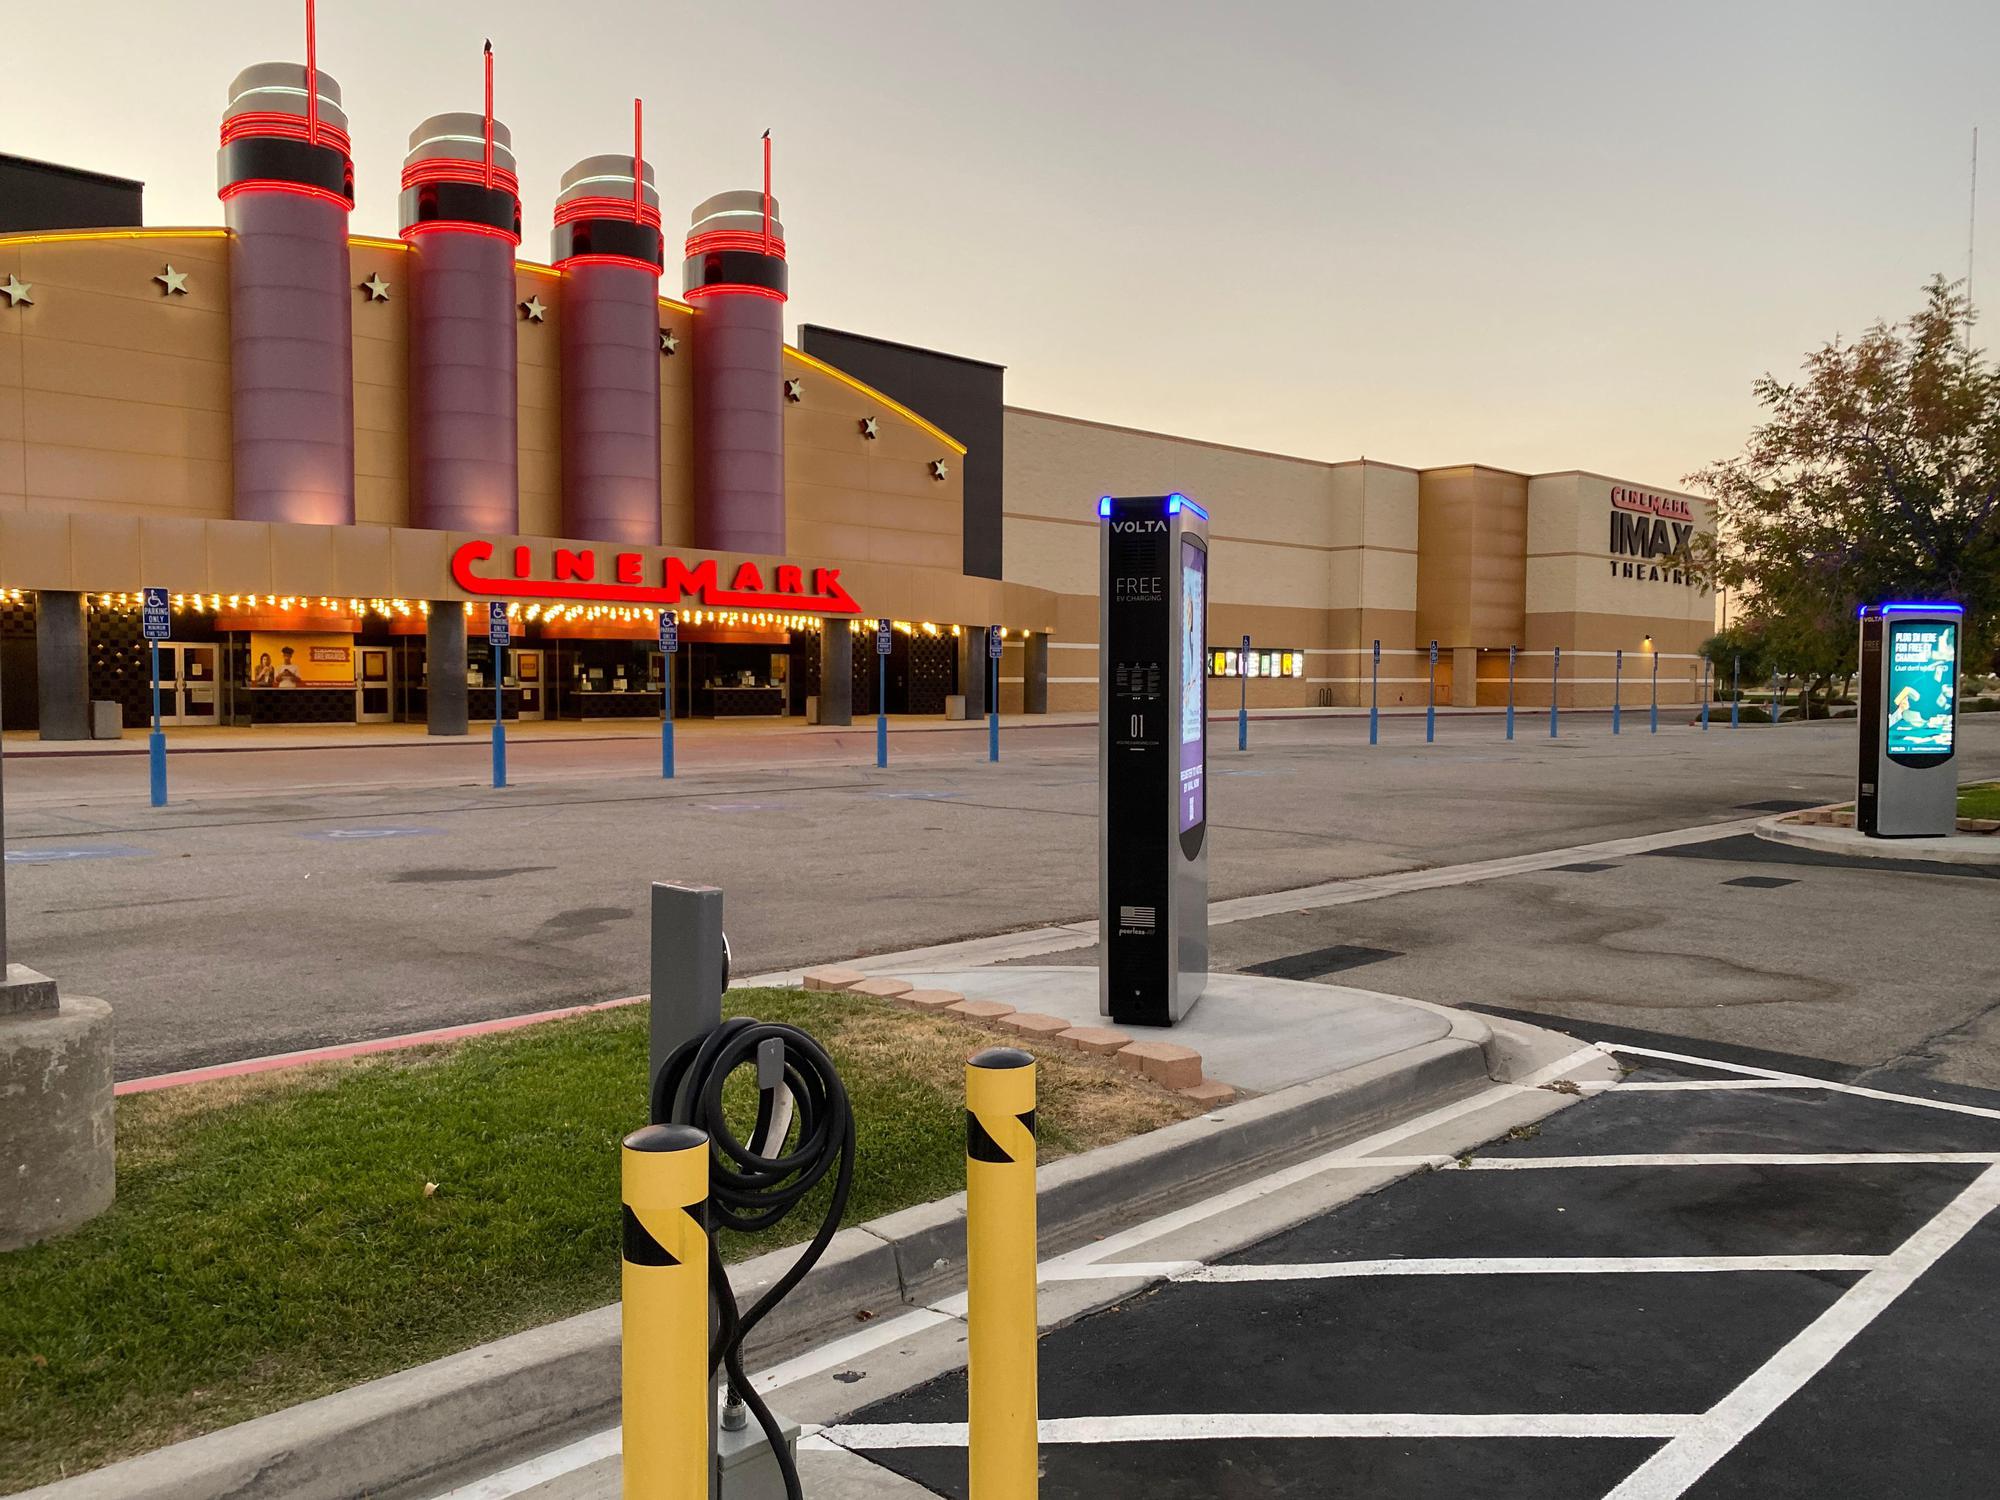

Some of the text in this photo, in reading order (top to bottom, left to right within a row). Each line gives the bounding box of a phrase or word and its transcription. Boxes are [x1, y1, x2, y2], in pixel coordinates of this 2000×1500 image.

[1611, 486, 1694, 522] CINEMARK
[1112, 520, 1168, 533] VOLTA
[1610, 511, 1693, 561] IMAX
[452, 540, 862, 613] CINEMARK
[1116, 577, 1162, 593] FREE
[1126, 594, 1162, 602] CHARGING
[144, 607, 168, 615] PARKING
[1131, 714, 1144, 738] 01
